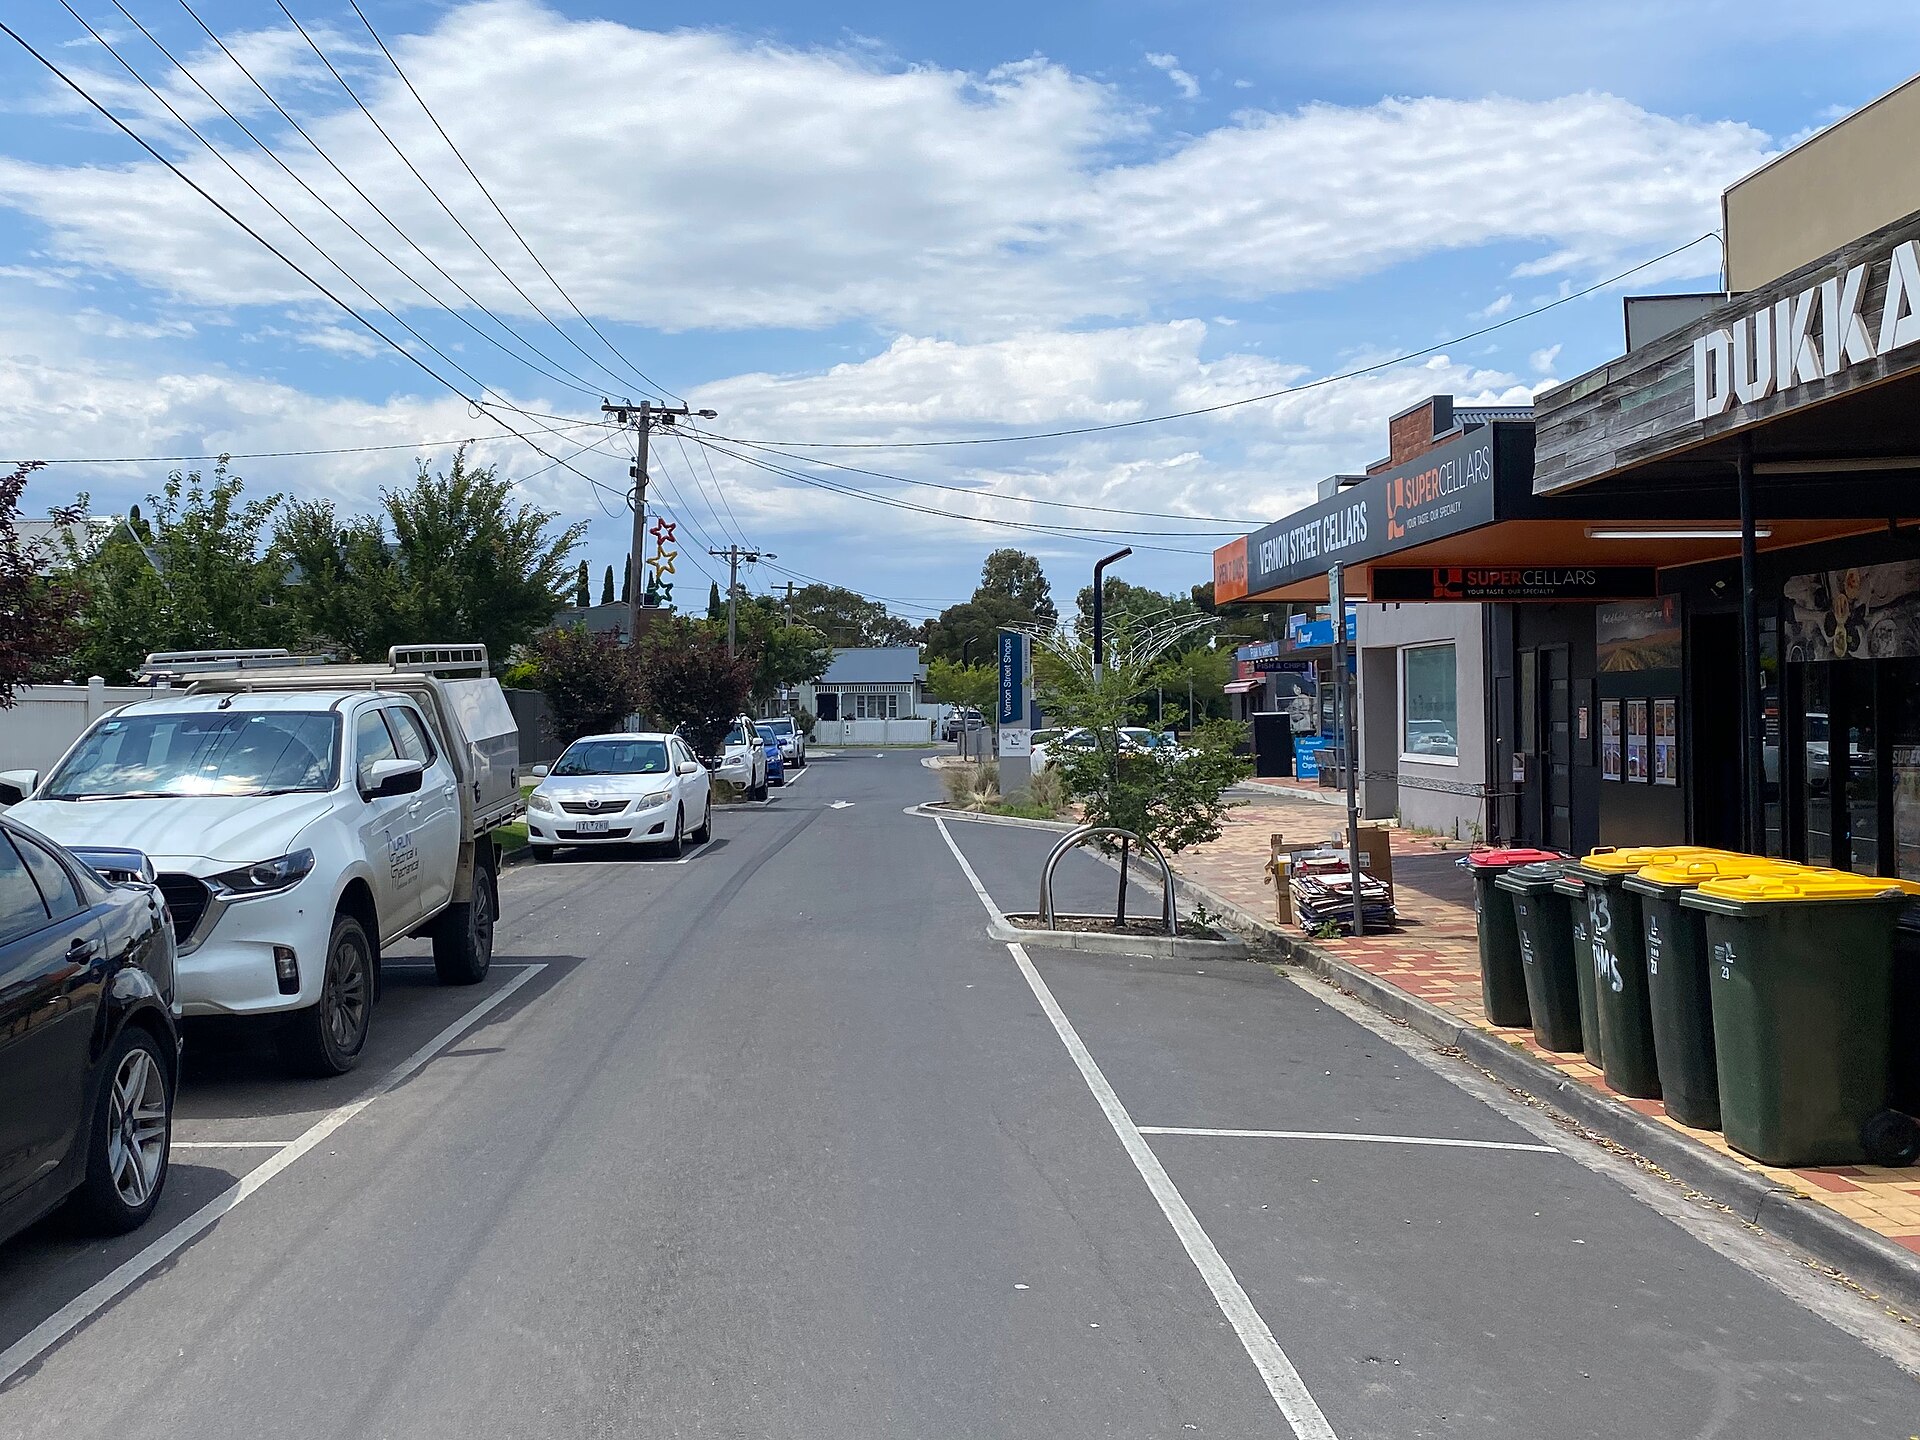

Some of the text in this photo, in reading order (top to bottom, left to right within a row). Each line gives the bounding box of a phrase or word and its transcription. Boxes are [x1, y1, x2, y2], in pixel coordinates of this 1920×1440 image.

[1405, 445, 1490, 510] SUPERCELLARS
[1259, 500, 1368, 575] VERNON STREET CELLARS
[1406, 515, 1417, 529] YOUR
[1430, 509, 1440, 522] OUR
[1467, 570, 1597, 586] SUPERCELLARS
[1003, 638, 1012, 718] Vernon Street Shops
